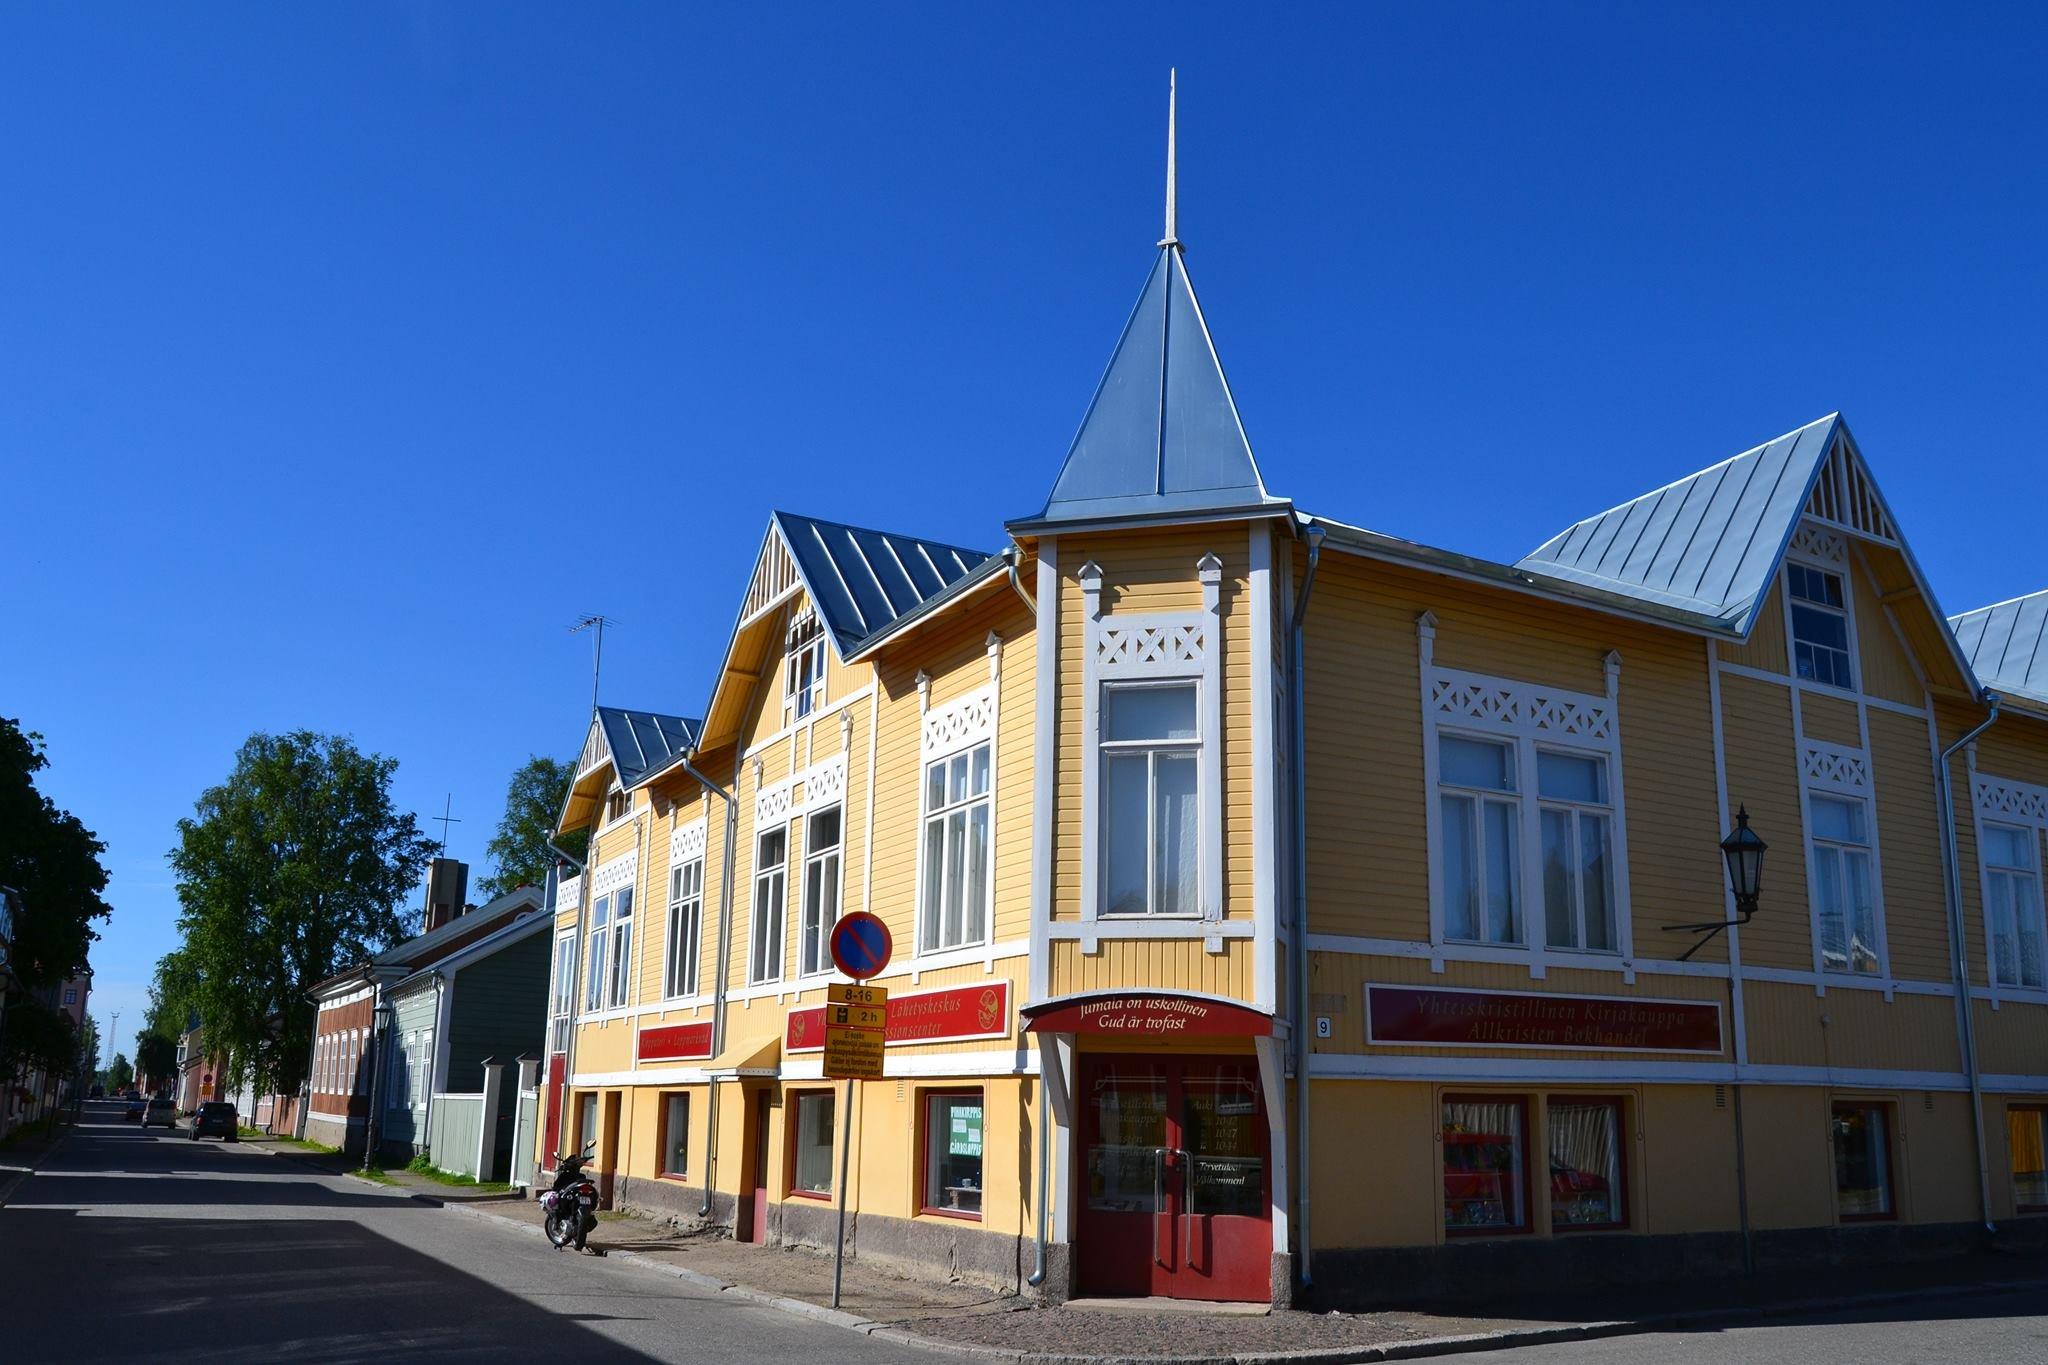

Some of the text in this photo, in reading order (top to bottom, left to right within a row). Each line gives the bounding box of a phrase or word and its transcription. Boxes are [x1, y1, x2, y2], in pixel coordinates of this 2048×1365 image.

[844, 988, 873, 1002] 8-16
[860, 1011, 878, 1022] 2 h
[891, 994, 961, 1021] Lähetyskeskus
[1081, 996, 1208, 1019] Jumala on uskollinen
[1416, 995, 1687, 1030] Yhteiskristillinen Kirjakauppa
[885, 1023, 942, 1039] ssionscenter
[1098, 1013, 1187, 1033] Gud är trofast
[1320, 1021, 1328, 1034] 9
[1467, 1022, 1650, 1045] Allkristen Bokhandel
